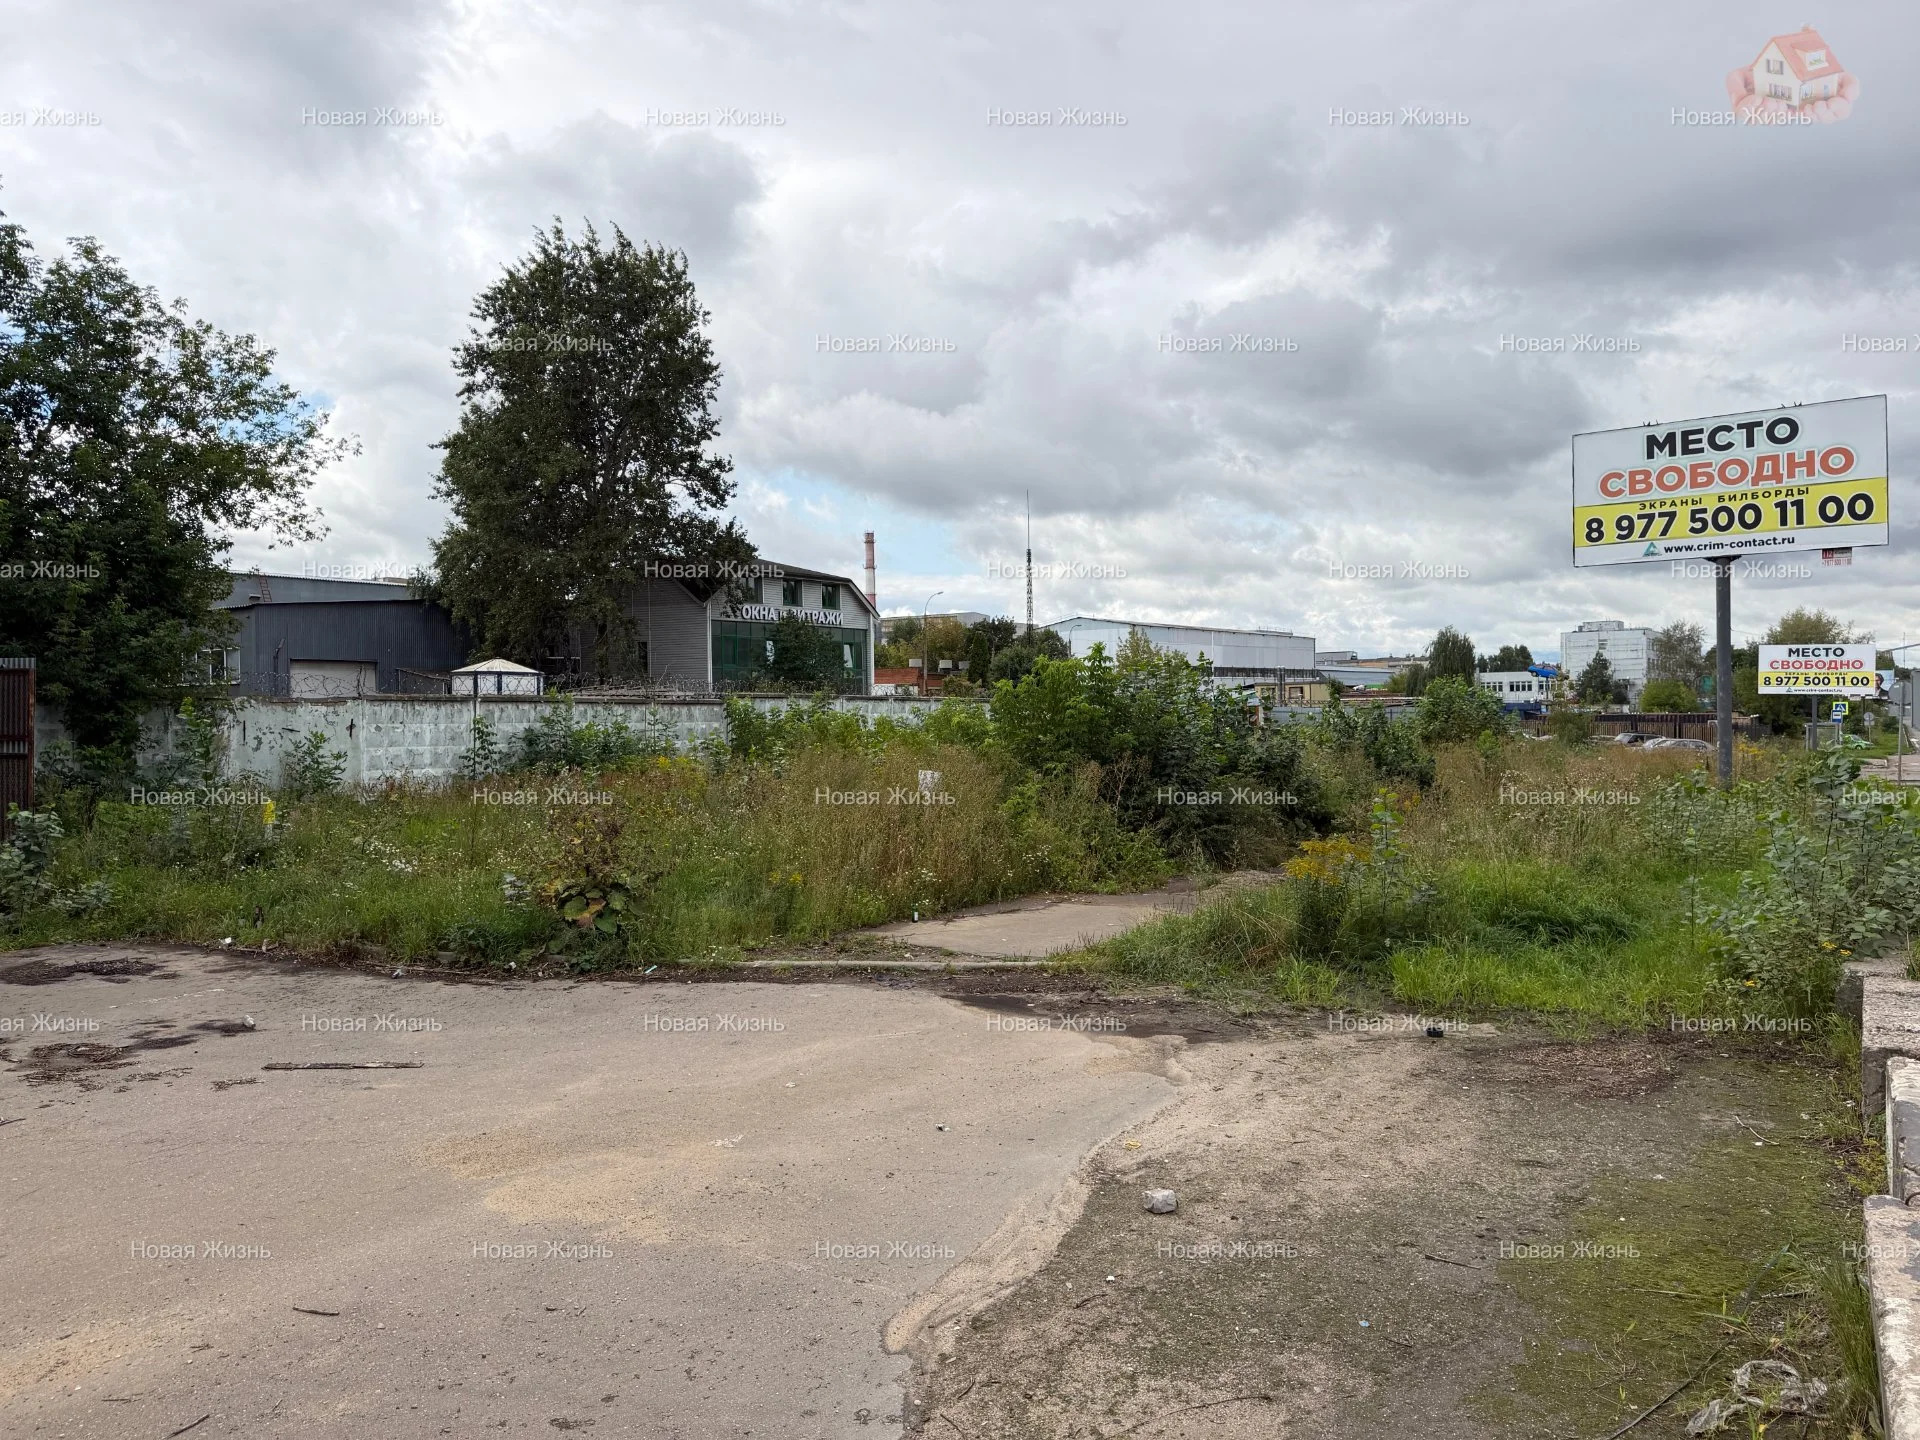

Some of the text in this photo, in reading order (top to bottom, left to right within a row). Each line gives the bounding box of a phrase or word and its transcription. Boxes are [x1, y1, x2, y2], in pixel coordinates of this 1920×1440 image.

[1646, 417, 1799, 459] МЕСТО
[1600, 446, 1855, 498] СВОБОДНО
[1639, 487, 1810, 511] ЭКРАНЫ БИЛБОРДЫ
[1585, 493, 1874, 543] 8 977 500 11 00
[1663, 535, 1795, 554] www.crim-contact.ru
[742, 604, 777, 620] ОКНА
[1788, 647, 1845, 657] МЕСТО
[1770, 659, 1864, 670] СВОБОДНО
[1763, 676, 1870, 686] 8 977 500 11 00
